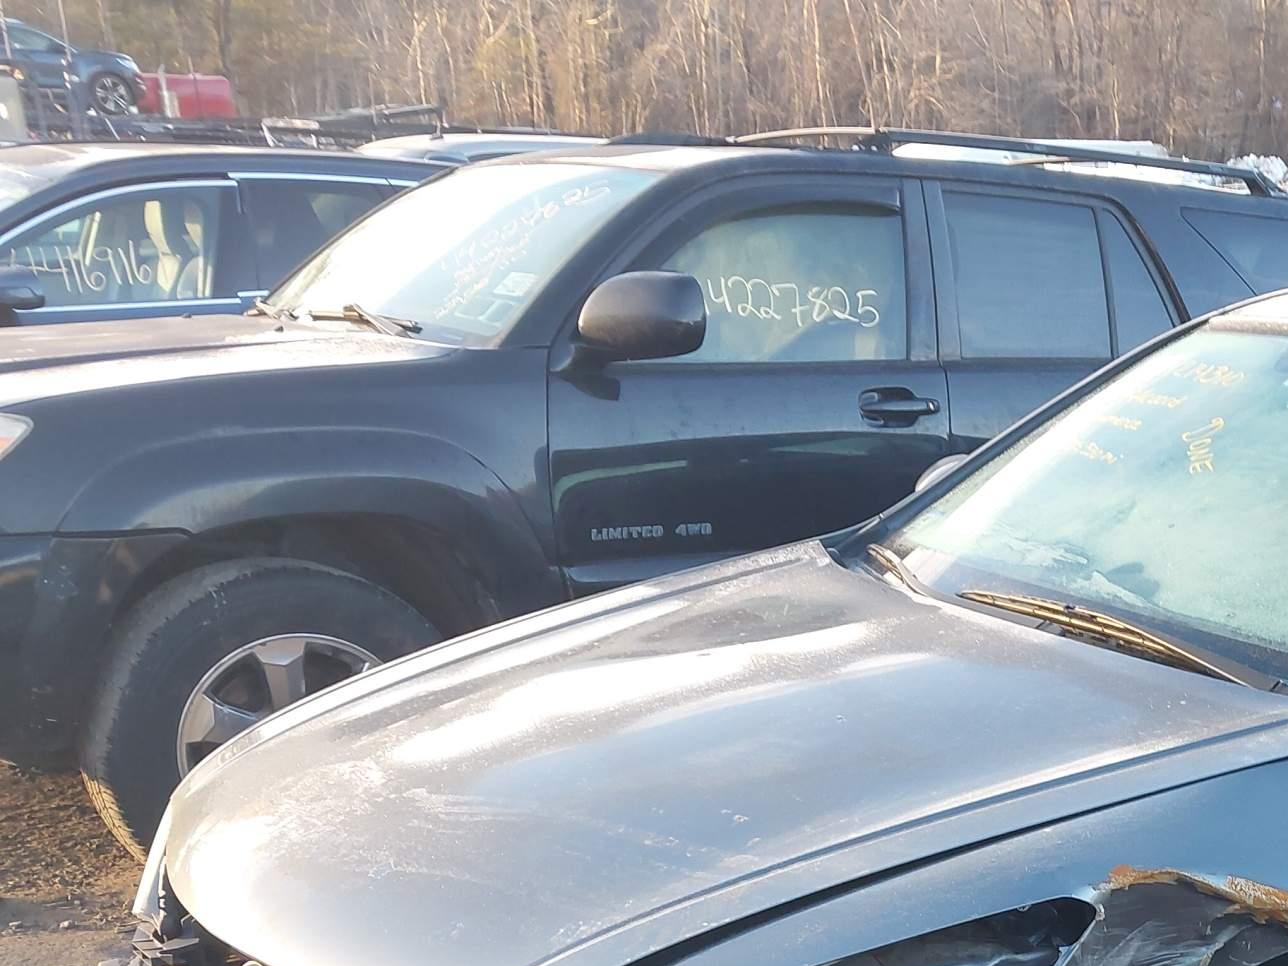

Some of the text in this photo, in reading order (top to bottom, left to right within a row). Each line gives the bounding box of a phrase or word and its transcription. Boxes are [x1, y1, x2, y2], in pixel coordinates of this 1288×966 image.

[704, 275, 880, 328] 4227825
[590, 522, 713, 542] LIMITED 4WD
